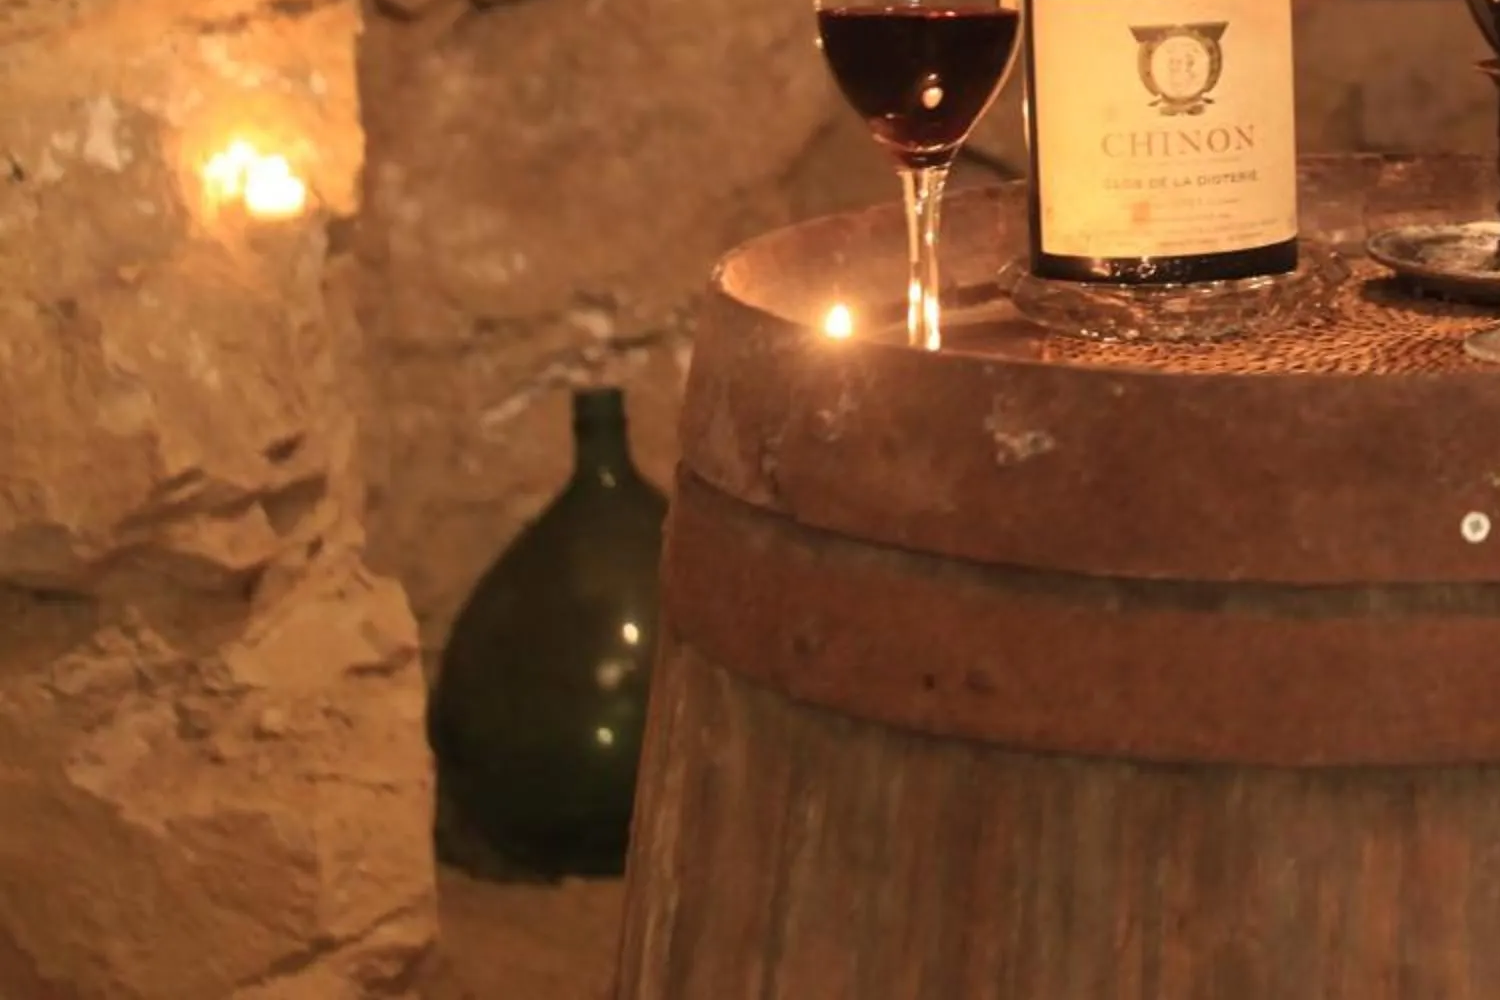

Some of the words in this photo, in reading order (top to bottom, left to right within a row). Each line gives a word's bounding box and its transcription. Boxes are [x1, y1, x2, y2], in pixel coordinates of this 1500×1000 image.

[1101, 124, 1255, 158] CHINON
[1149, 175, 1167, 189] DE
[1173, 174, 1192, 188] LA
